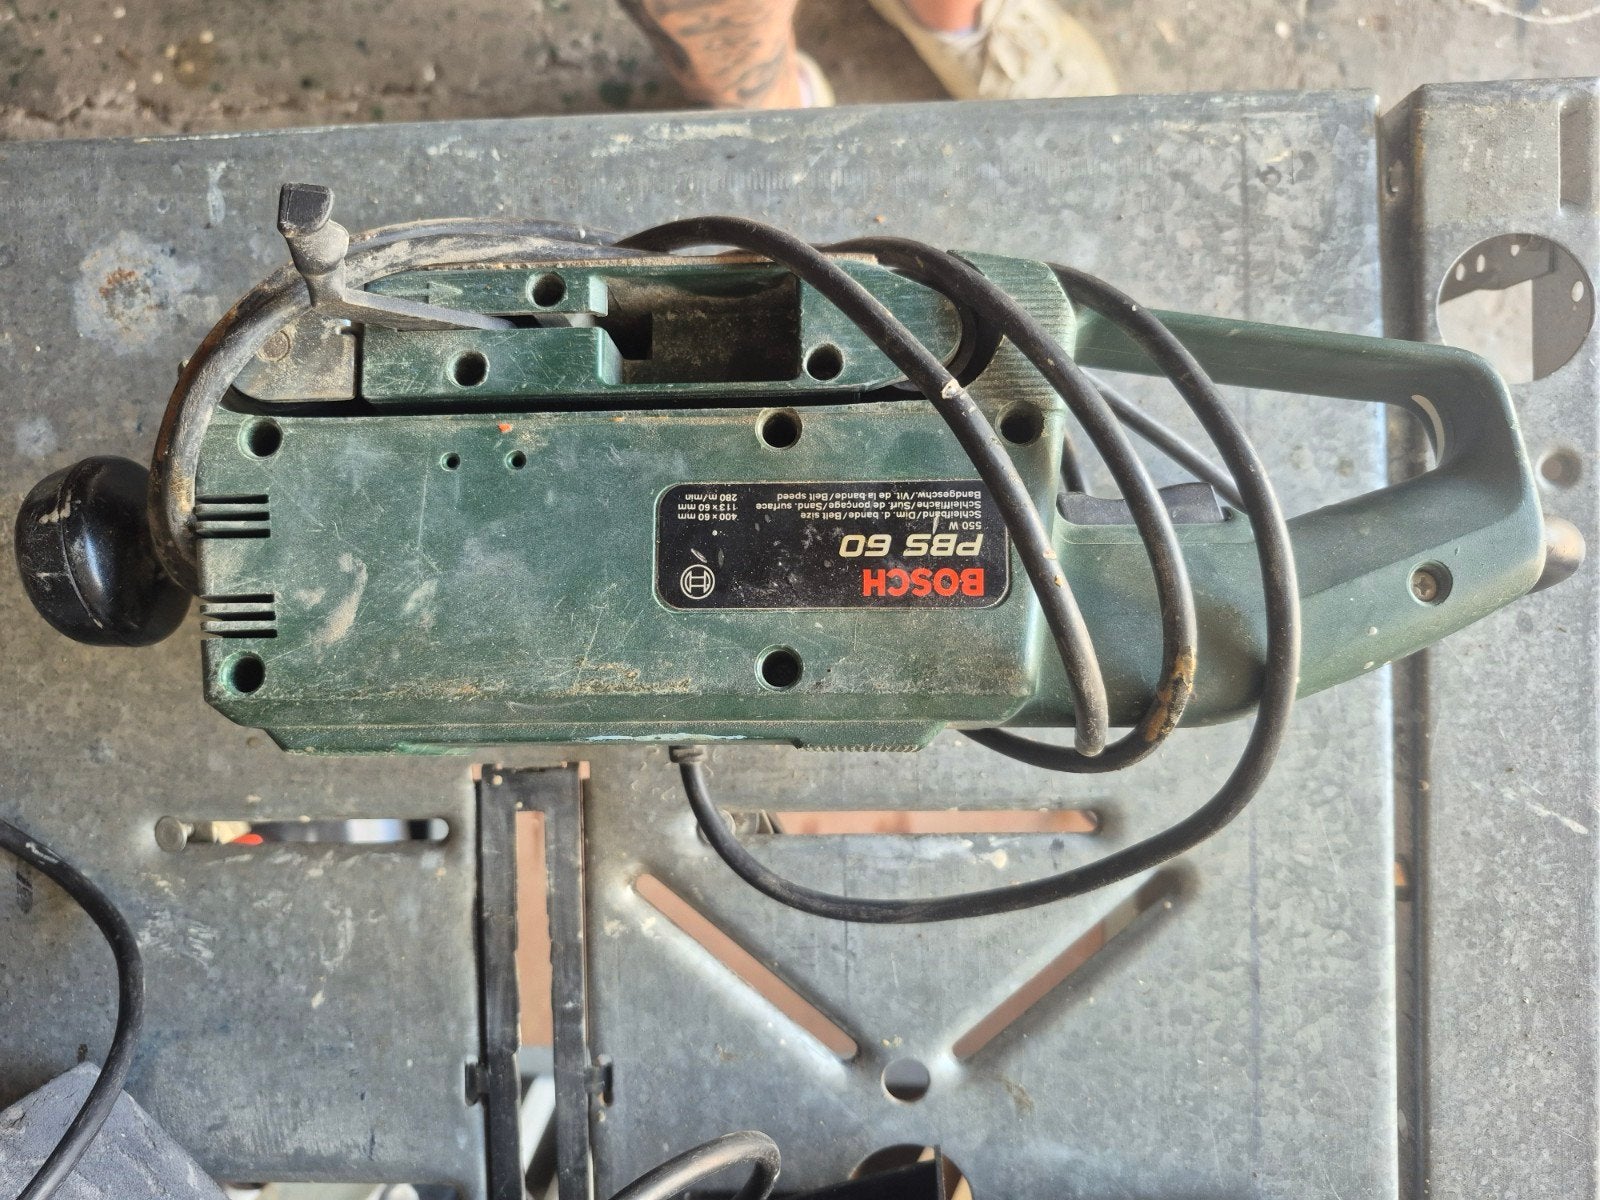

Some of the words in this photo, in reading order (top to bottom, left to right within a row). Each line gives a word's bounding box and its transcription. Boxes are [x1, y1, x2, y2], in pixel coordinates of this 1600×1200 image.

[685, 493, 718, 502] m/min
[719, 493, 738, 502] 280
[777, 492, 806, 501] speed
[809, 492, 866, 501] bande/Belt
[868, 492, 877, 501] la
[878, 492, 892, 500] de
[893, 490, 982, 500] Bandgeschw./Vit.
[698, 503, 711, 512] 60
[719, 503, 737, 511] 113
[755, 503, 792, 511] surface
[794, 501, 871, 511] ponçage/Sand.
[873, 502, 886, 510] de
[888, 500, 982, 510] Schleiffläche/Surf.
[698, 513, 710, 521] 60
[719, 513, 738, 521] 400
[800, 512, 820, 520] size
[822, 512, 879, 520] bande/Belt
[881, 511, 891, 519] d.
[893, 510, 982, 519] Schleifband/Dim.
[948, 521, 959, 530] W
[962, 521, 982, 530] 550
[839, 534, 892, 557] 60
[902, 533, 984, 557] PBS
[862, 568, 984, 597] BOSCH
